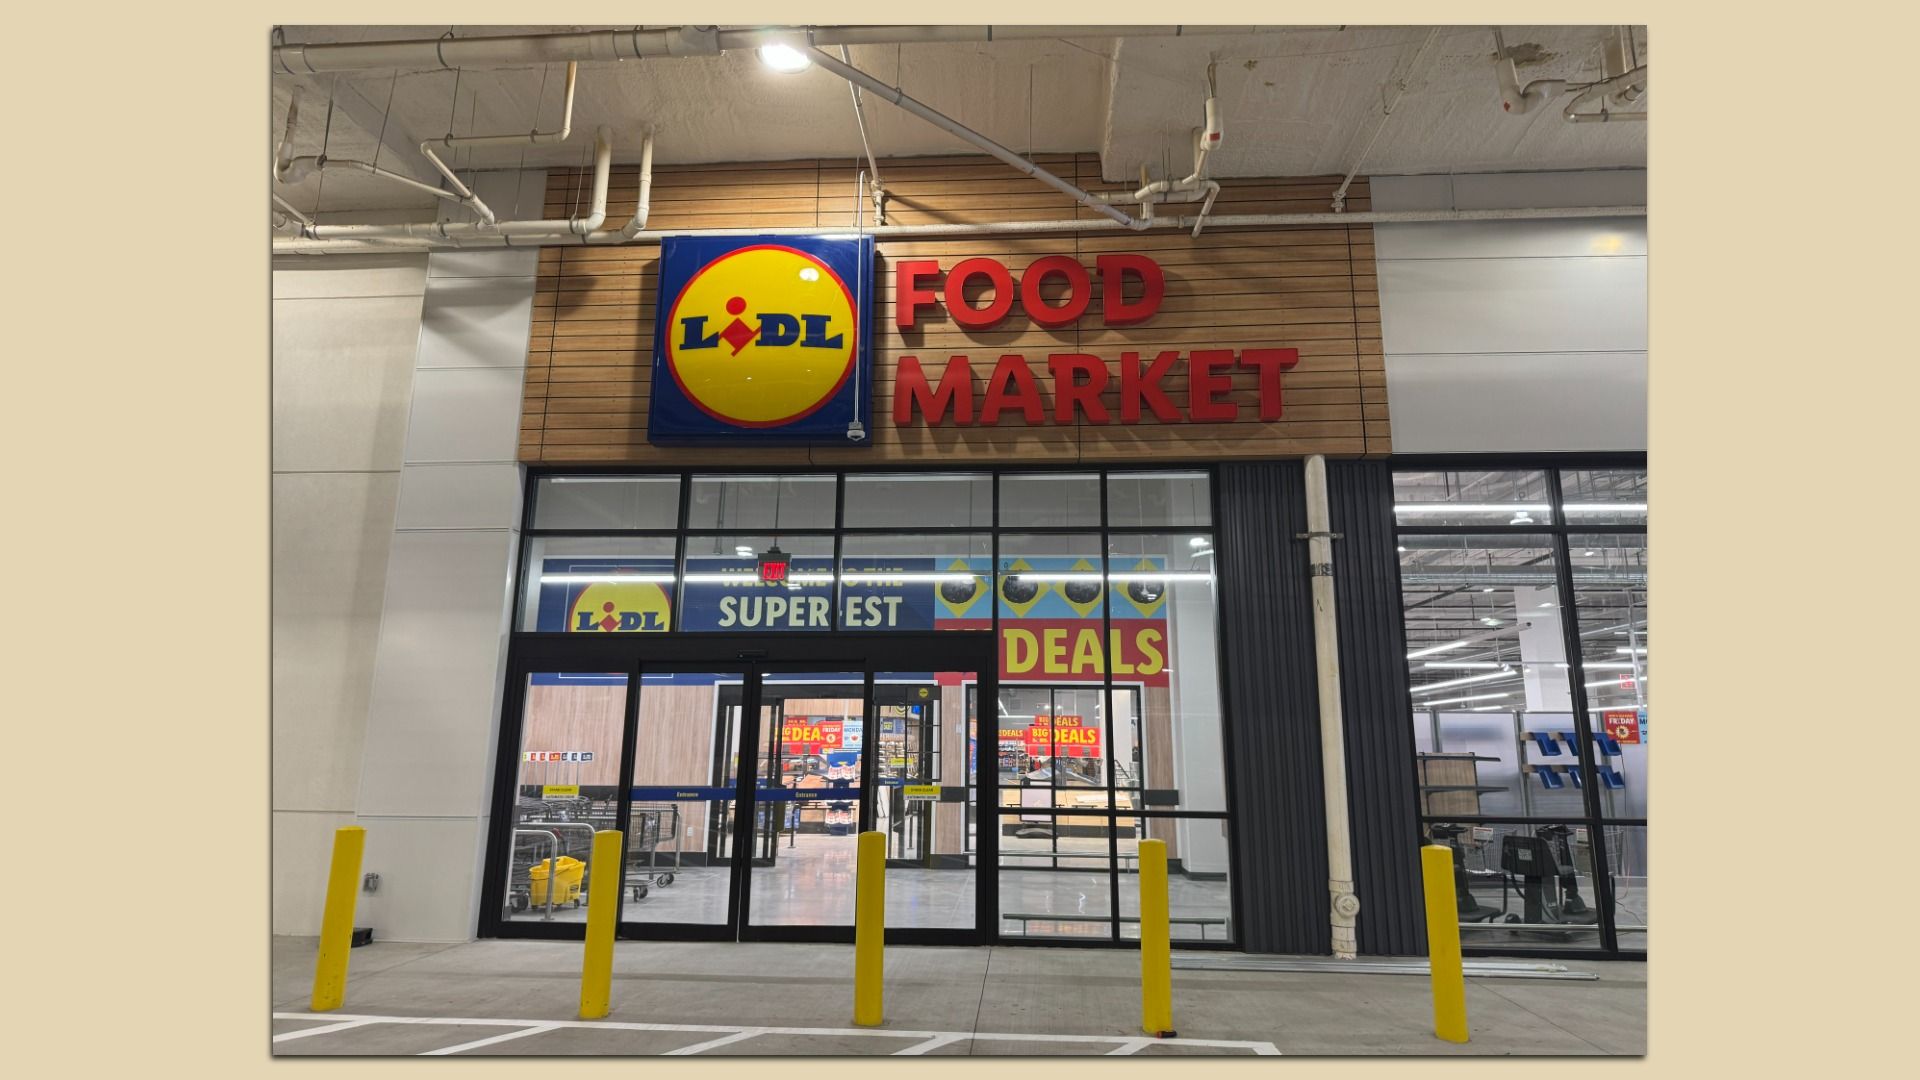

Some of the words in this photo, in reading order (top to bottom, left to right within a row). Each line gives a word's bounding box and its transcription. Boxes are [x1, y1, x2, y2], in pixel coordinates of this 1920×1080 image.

[895, 254, 1165, 330] FOOD
[893, 348, 1298, 426] MARKET
[1003, 628, 1163, 674] DEALS
[1032, 728, 1049, 737] BIG
[1055, 717, 1079, 727] EALS
[1608, 717, 1634, 725] FRIDAY
